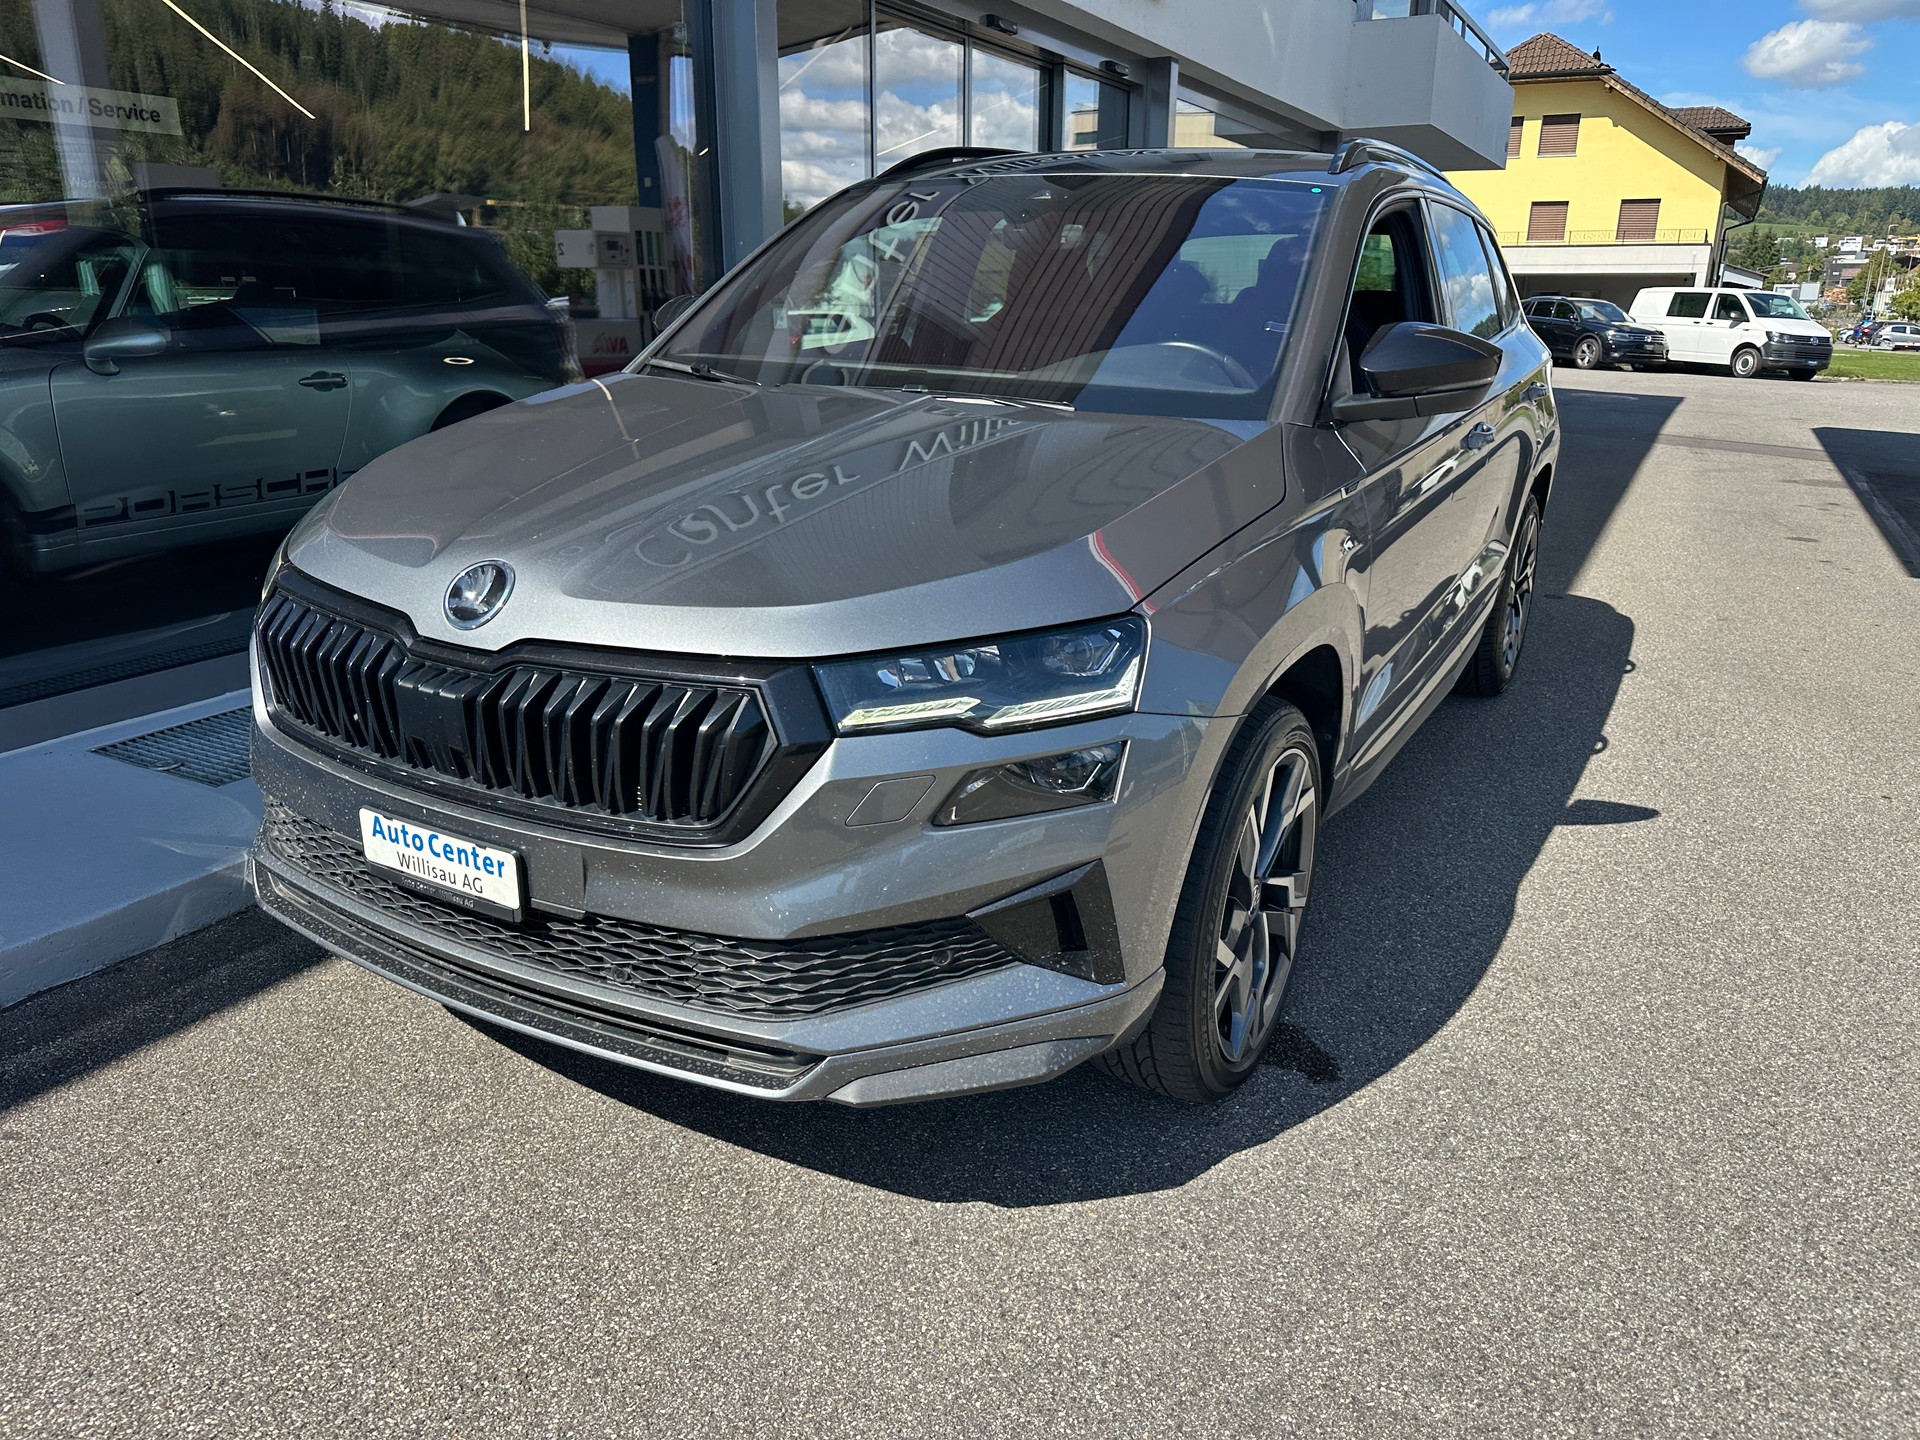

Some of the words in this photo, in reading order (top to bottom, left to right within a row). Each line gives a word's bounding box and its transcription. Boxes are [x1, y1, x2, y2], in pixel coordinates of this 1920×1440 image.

[89, 97, 161, 123] Service
[396, 851, 457, 886] Willisau
[462, 873, 484, 894] AG
